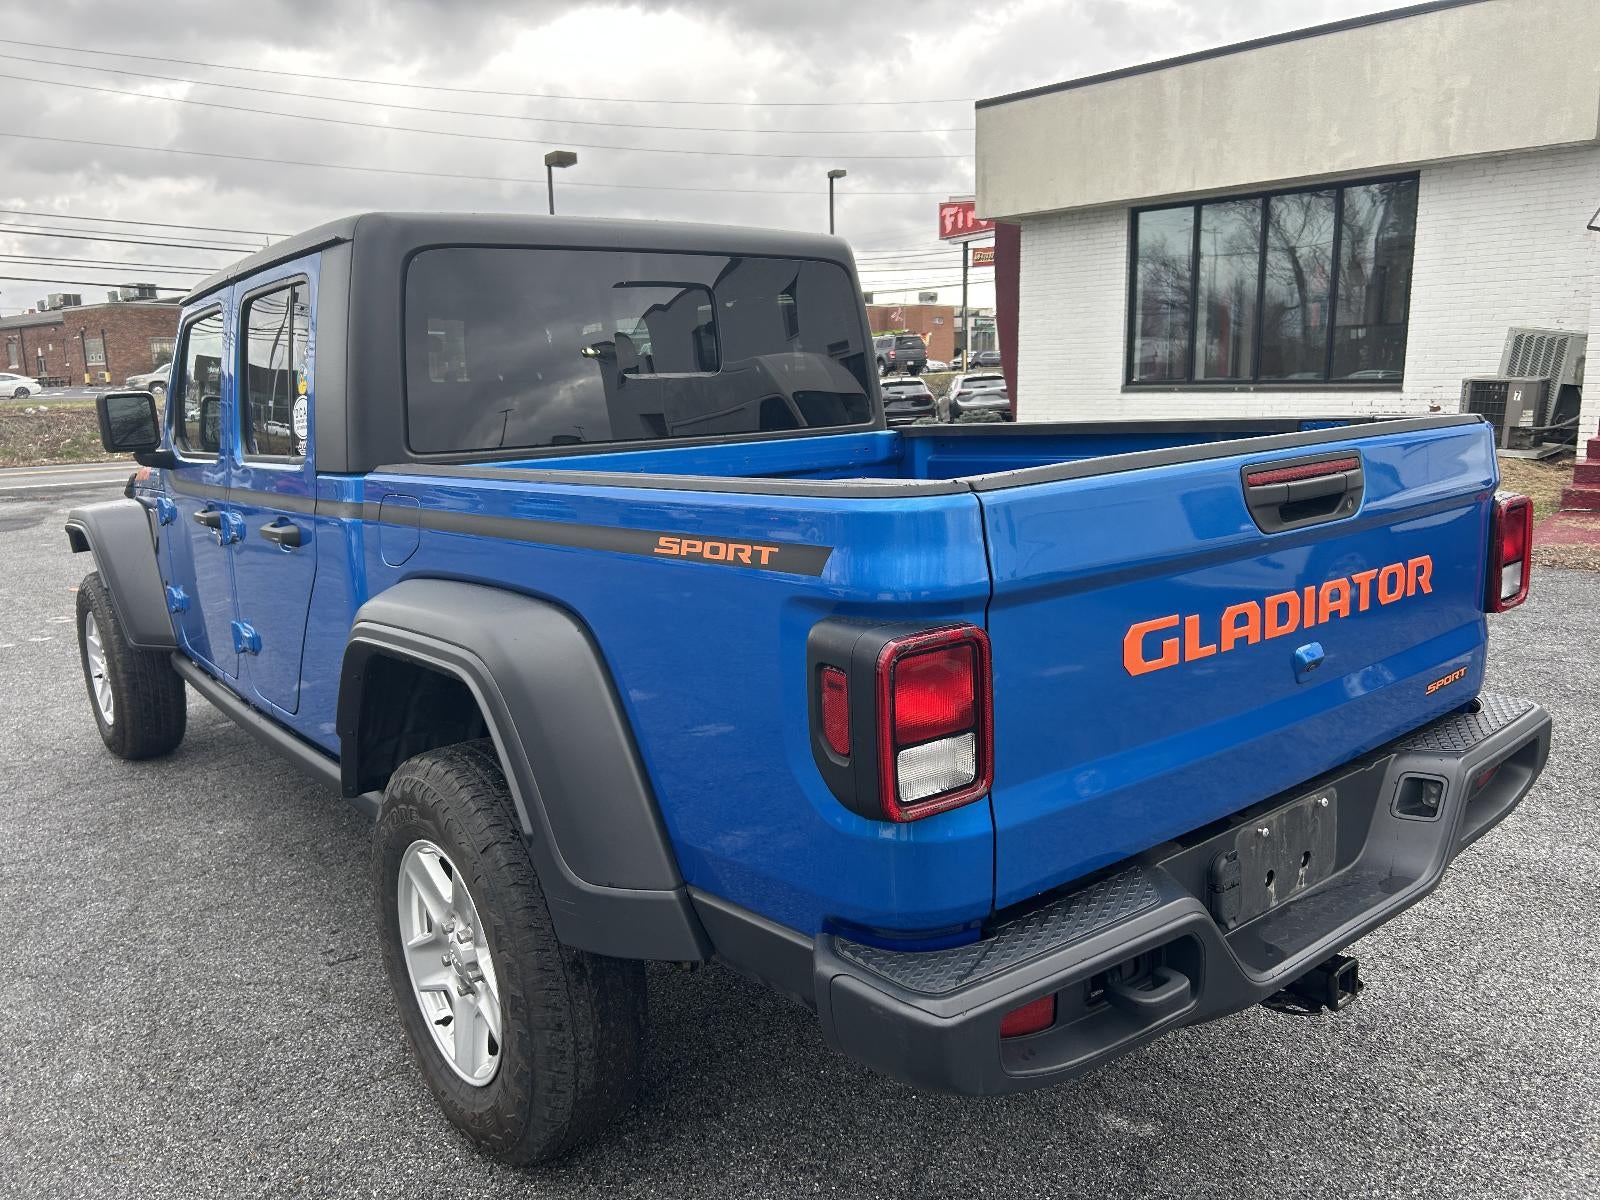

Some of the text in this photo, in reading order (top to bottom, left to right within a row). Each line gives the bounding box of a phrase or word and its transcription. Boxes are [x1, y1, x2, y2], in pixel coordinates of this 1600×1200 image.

[654, 536, 779, 565] SPORT
[1123, 554, 1433, 677] GLADIATOR
[1425, 666, 1468, 695] SPORT
